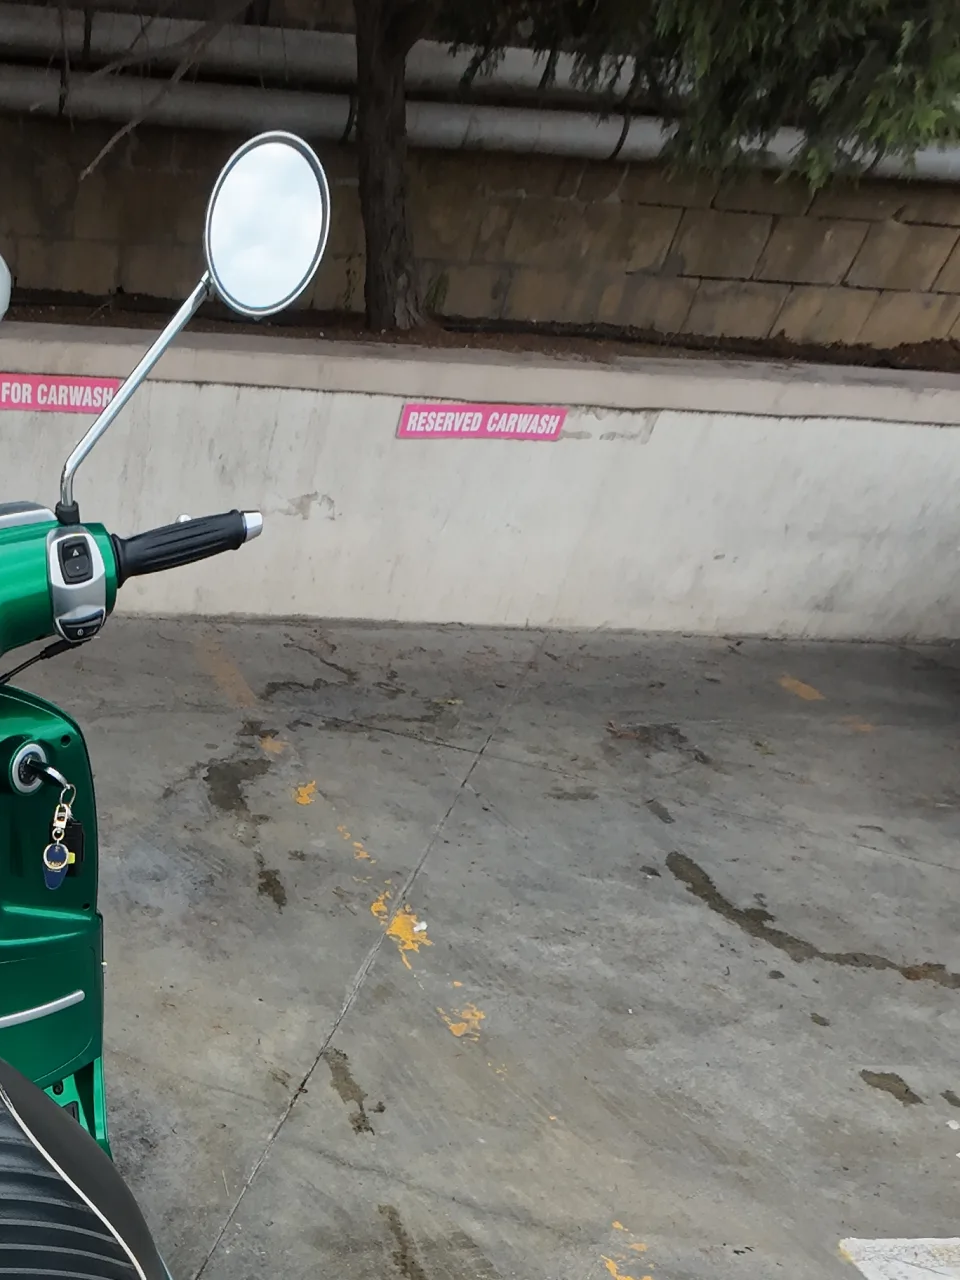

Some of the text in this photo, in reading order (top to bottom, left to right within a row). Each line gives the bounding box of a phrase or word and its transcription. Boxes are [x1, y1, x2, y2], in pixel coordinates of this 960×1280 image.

[1, 382, 32, 404] FOR
[37, 384, 114, 408] CARWASH
[406, 411, 561, 434] RESERVED CARWASH
